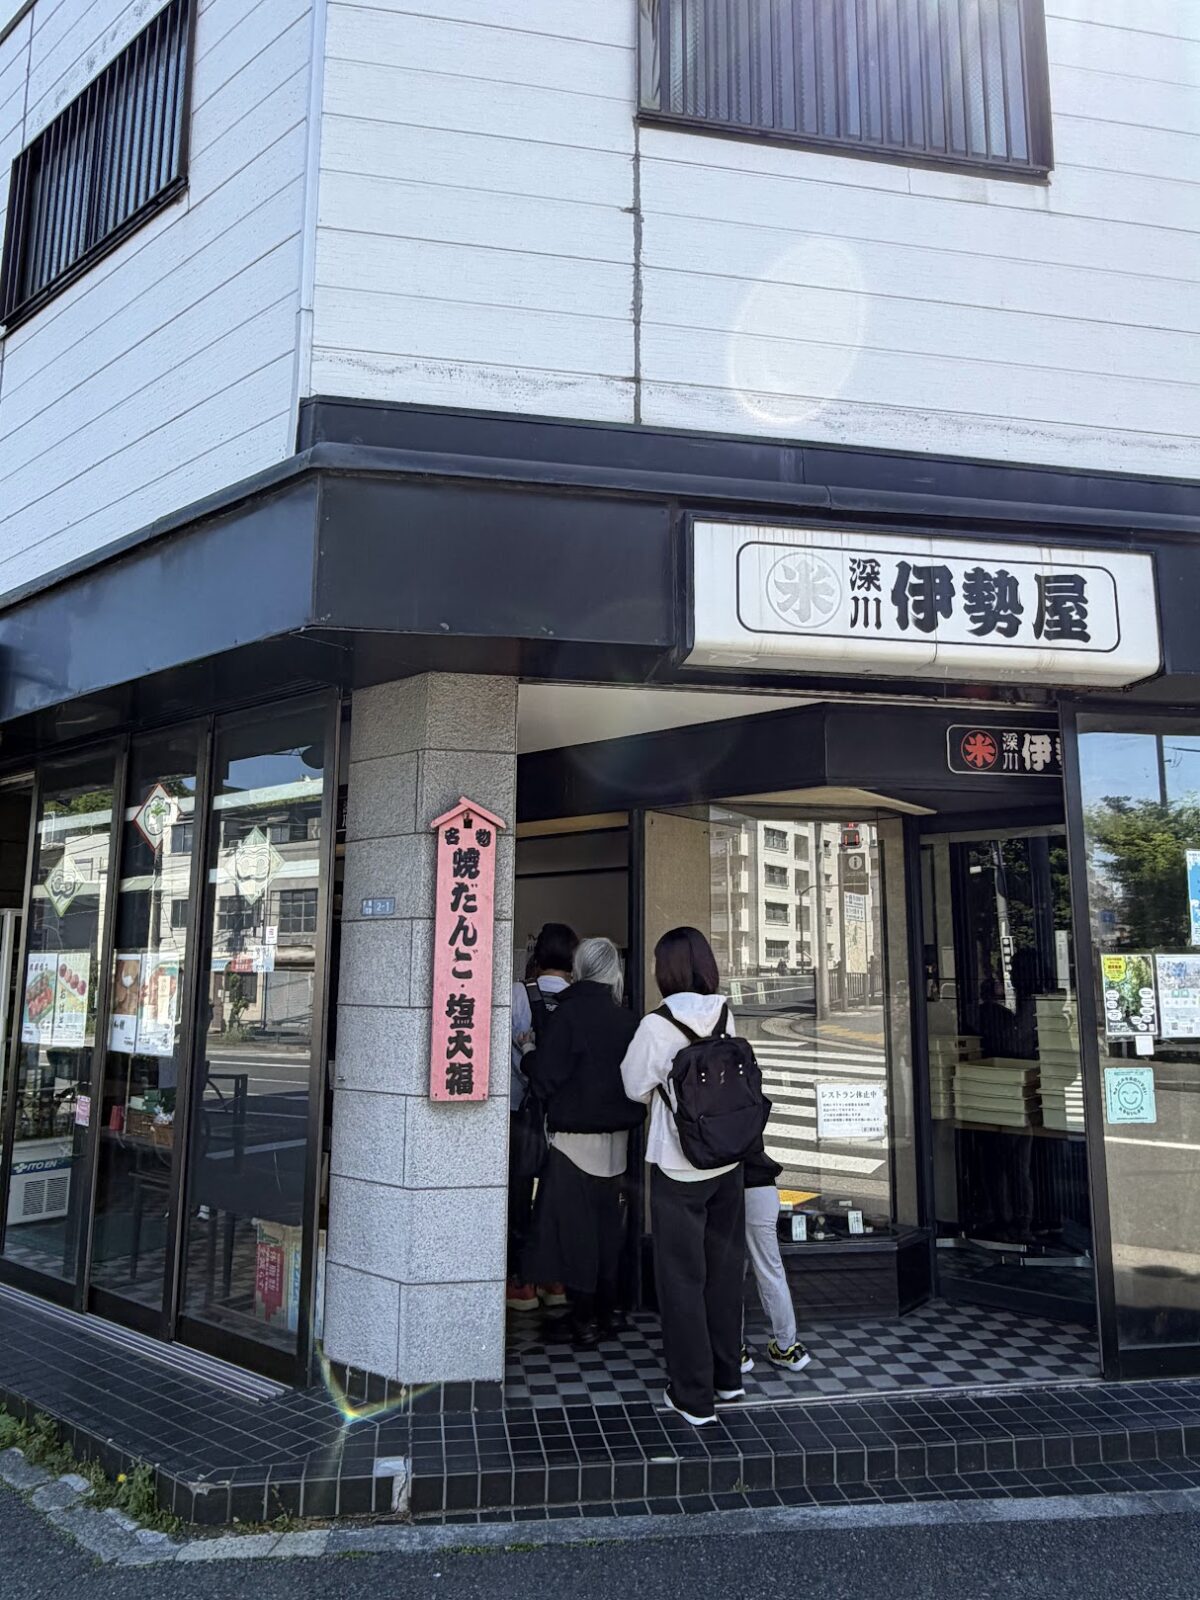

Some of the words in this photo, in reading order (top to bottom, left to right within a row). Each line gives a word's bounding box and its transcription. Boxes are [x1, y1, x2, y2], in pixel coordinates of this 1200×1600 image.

[849, 557, 882, 630] 深川
[890, 560, 1092, 644] 伊勢屋
[1002, 732, 1019, 770] 深川
[444, 827, 491, 847] 名物
[821, 1090, 877, 1099] レストラン休止中
[27, 1161, 43, 1171] ITO
[44, 1160, 58, 1168] EN
